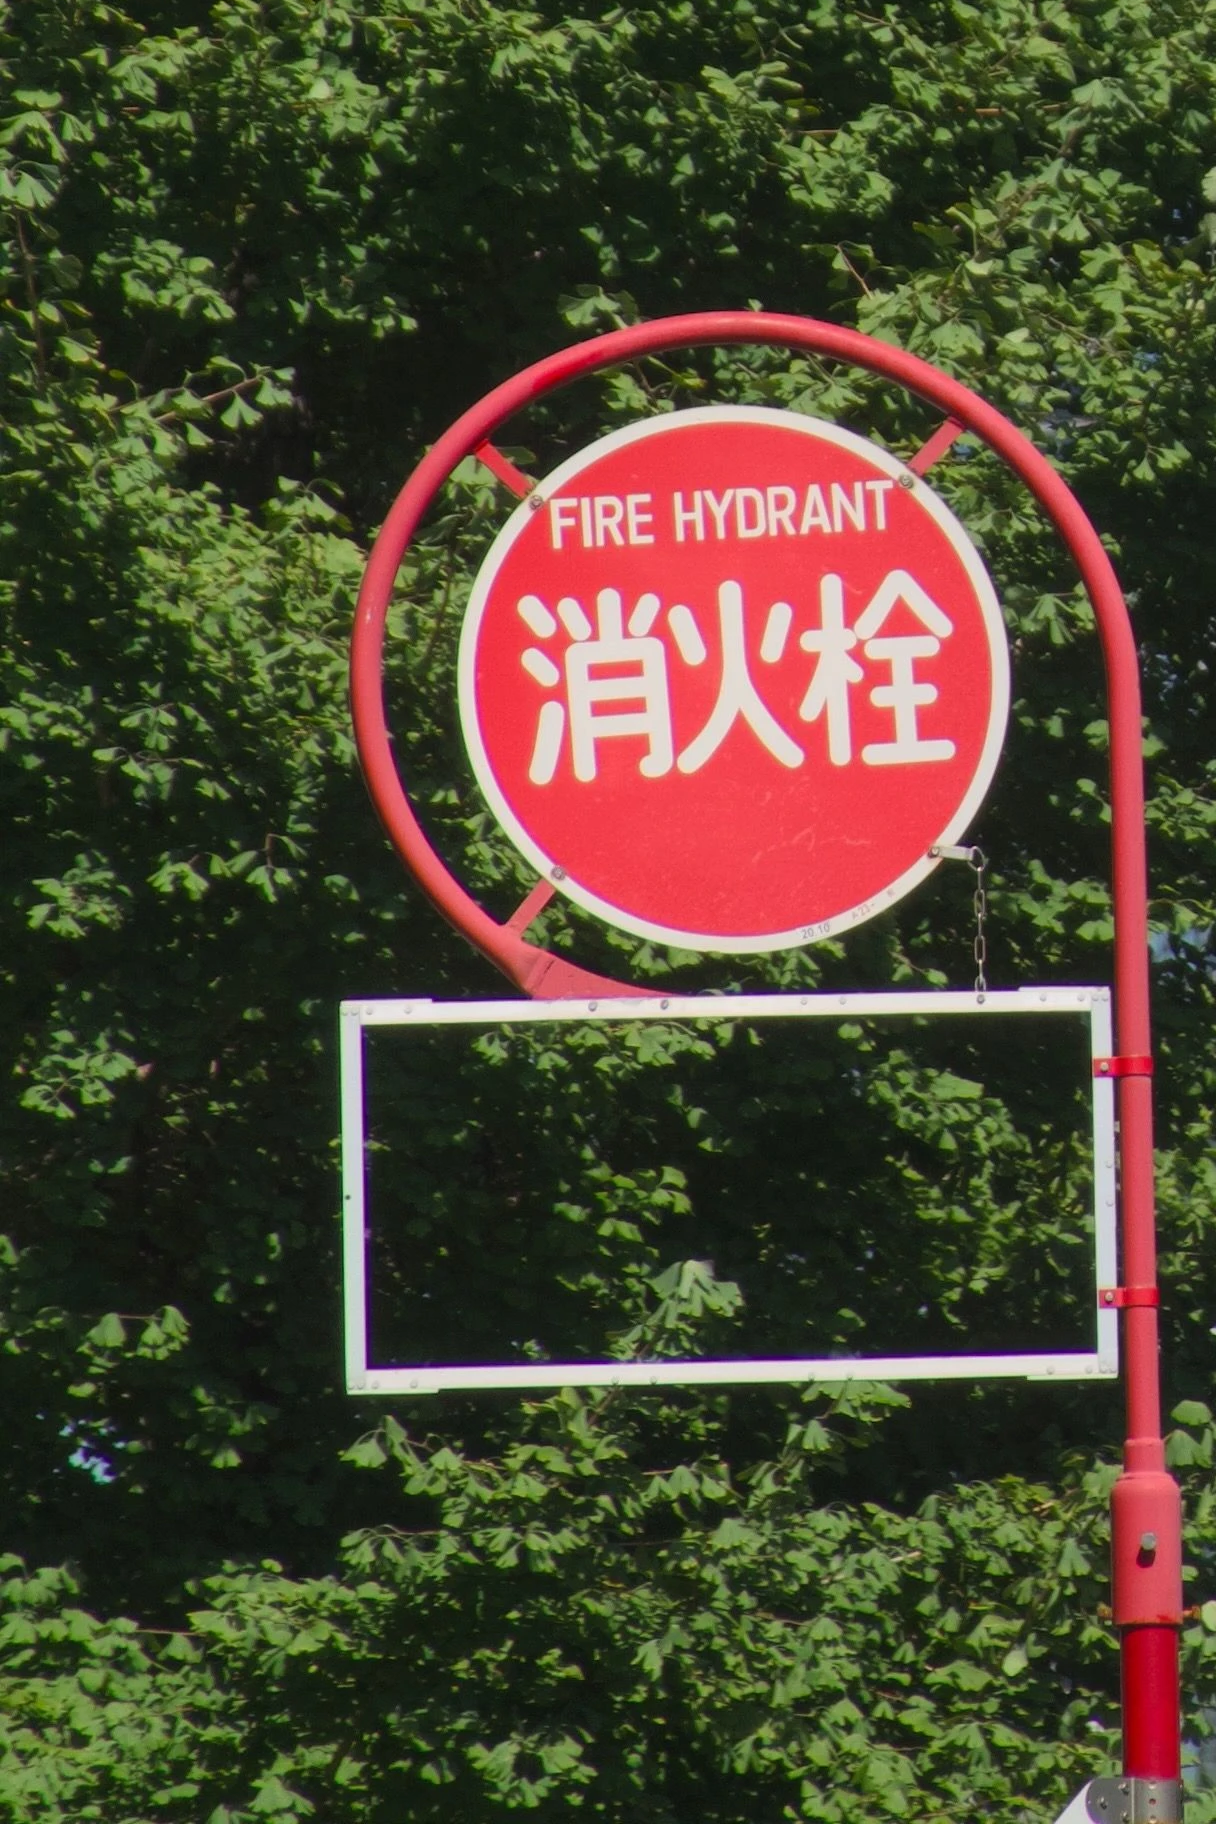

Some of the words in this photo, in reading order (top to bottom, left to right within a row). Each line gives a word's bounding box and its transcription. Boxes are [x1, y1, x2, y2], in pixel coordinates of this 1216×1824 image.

[550, 494, 654, 549] FIRE
[673, 480, 893, 542] HYDRANT
[517, 569, 956, 785] 消火栓
